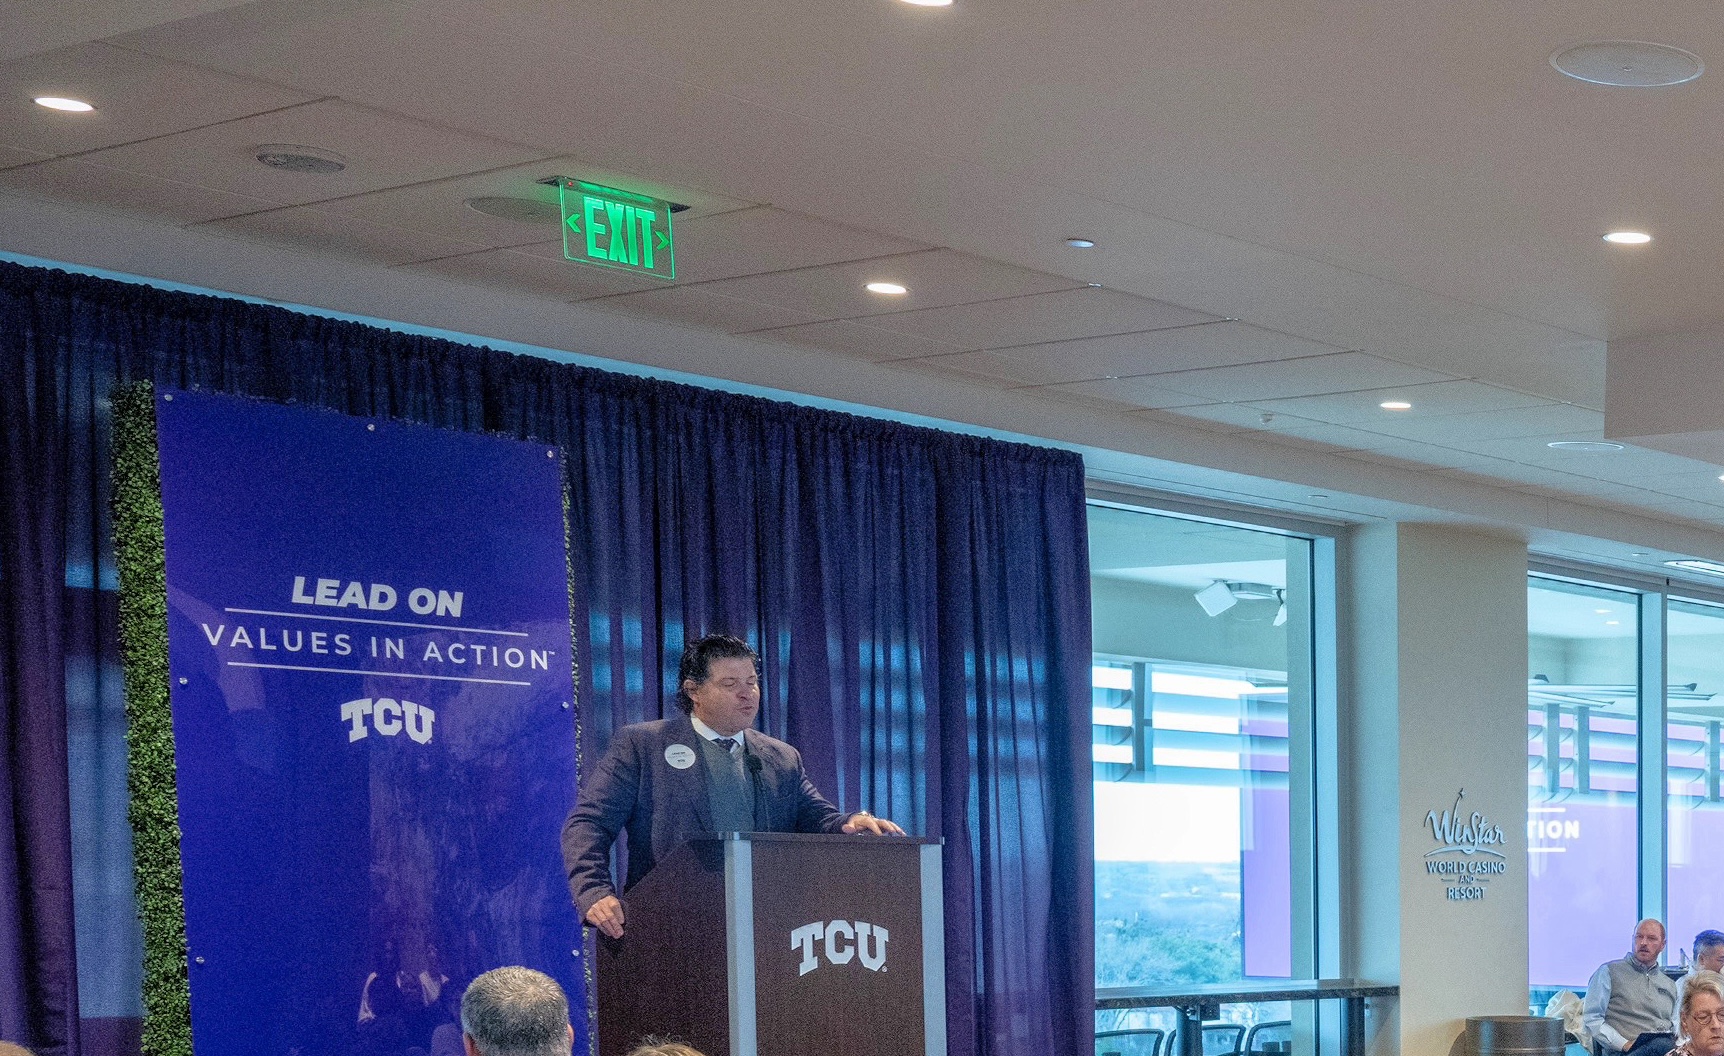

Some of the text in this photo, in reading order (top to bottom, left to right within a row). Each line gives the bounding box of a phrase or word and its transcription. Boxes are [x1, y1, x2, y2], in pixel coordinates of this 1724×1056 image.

[583, 195, 656, 269] EXIT
[292, 576, 463, 617] LEAD ON
[202, 623, 351, 655] VALUES
[372, 637, 404, 660] IN
[341, 698, 434, 745] TCU
[1424, 800, 1507, 851] WinStar
[1528, 820, 1580, 839] TION
[1425, 861, 1507, 875] WORLD CASINO
[1458, 875, 1475, 884] AND
[1447, 887, 1487, 900] RESORT
[791, 919, 889, 976] TCU
